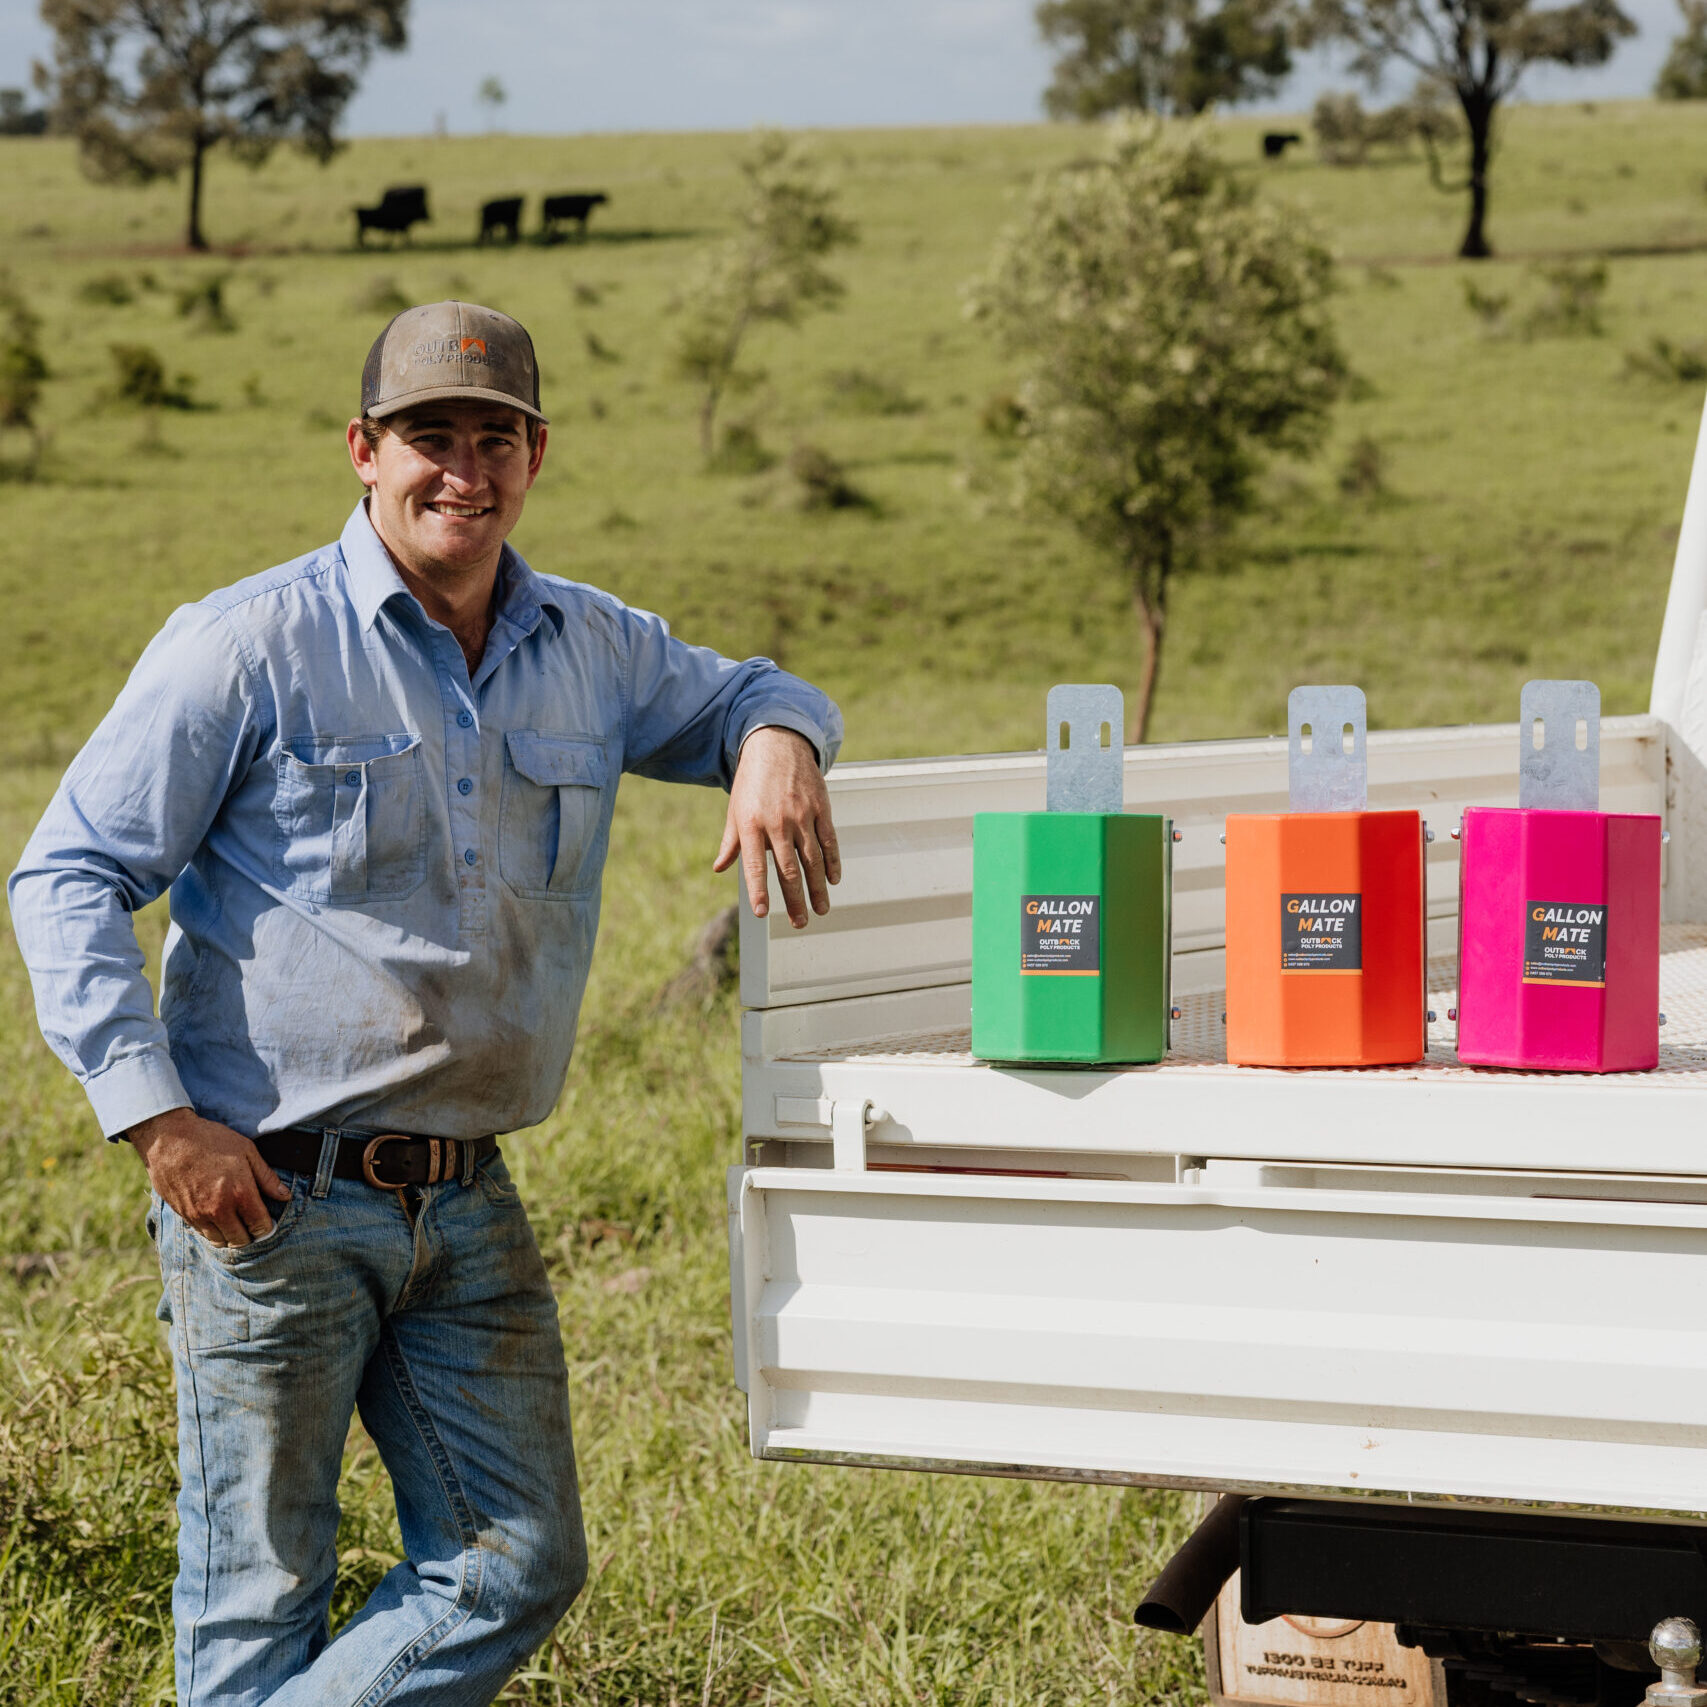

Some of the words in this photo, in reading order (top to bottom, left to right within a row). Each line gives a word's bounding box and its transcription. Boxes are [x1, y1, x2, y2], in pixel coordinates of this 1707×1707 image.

[1026, 901, 1094, 915] GALLON
[1287, 899, 1356, 913] GALLON
[1532, 907, 1603, 925] GALLON
[1036, 919, 1083, 933] MATE
[1298, 917, 1345, 932] MATE
[1542, 926, 1591, 943] MATE
[1263, 1652, 1306, 1667] 1300
[1310, 1656, 1335, 1670] BE
[1341, 1659, 1384, 1673] TUFF
